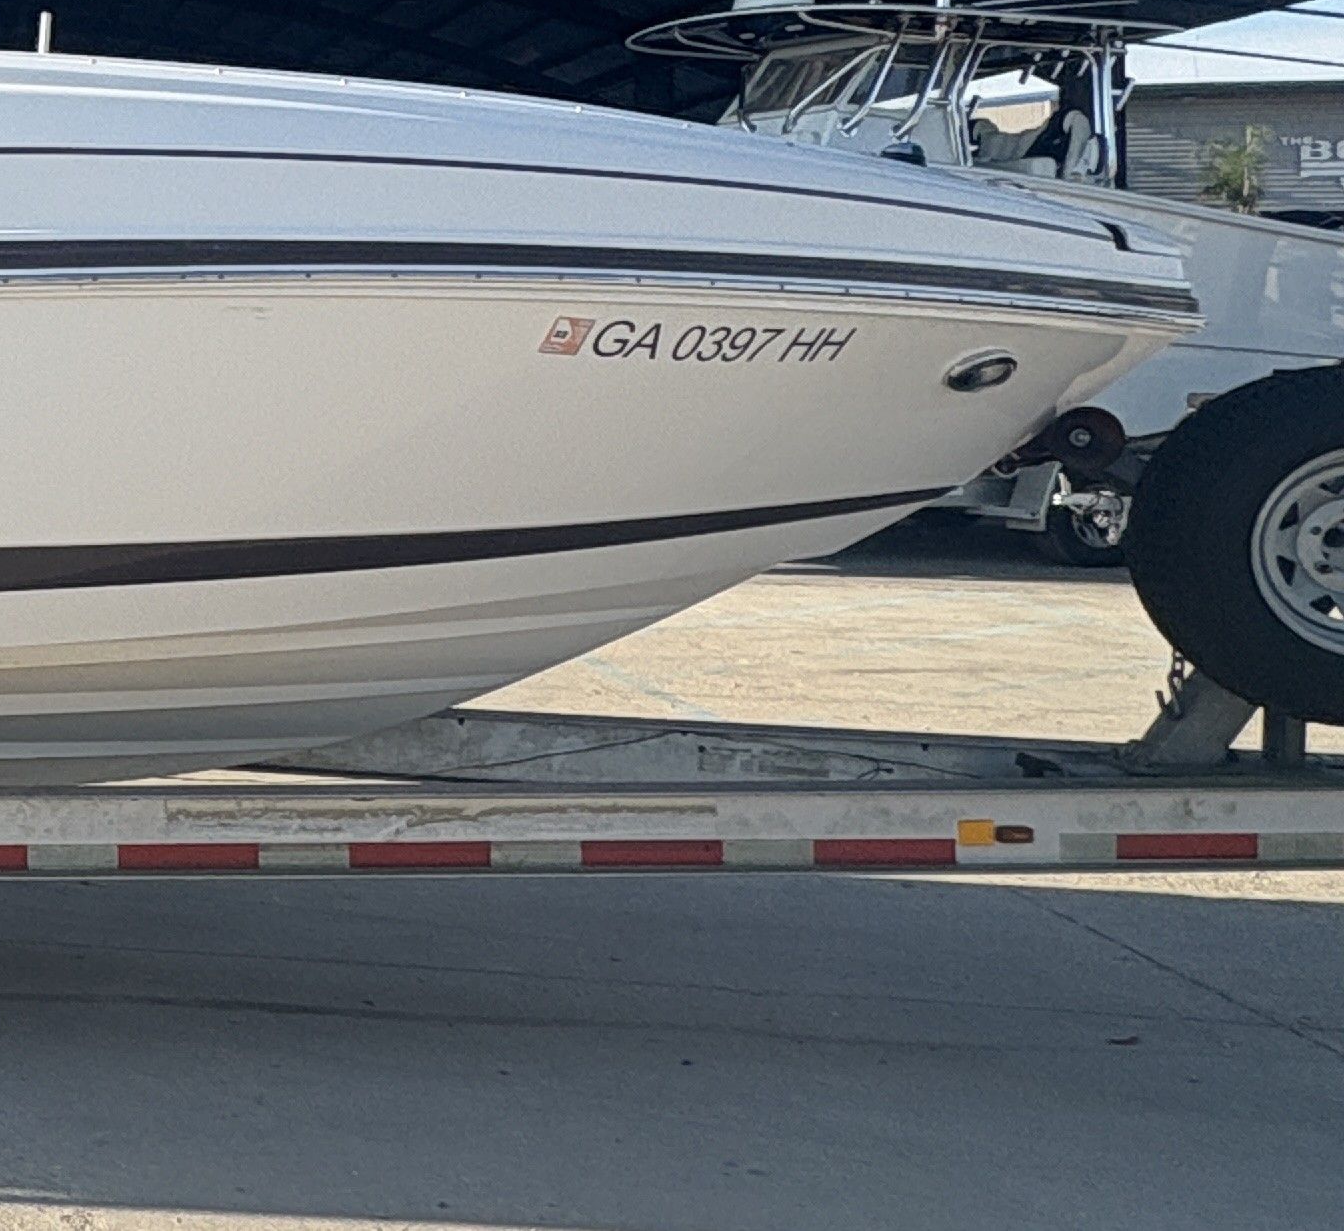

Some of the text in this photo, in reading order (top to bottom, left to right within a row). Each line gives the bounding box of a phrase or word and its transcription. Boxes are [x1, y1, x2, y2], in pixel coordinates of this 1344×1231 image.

[1279, 135, 1344, 161] THE B
[592, 320, 858, 363] GA 0397 HH
